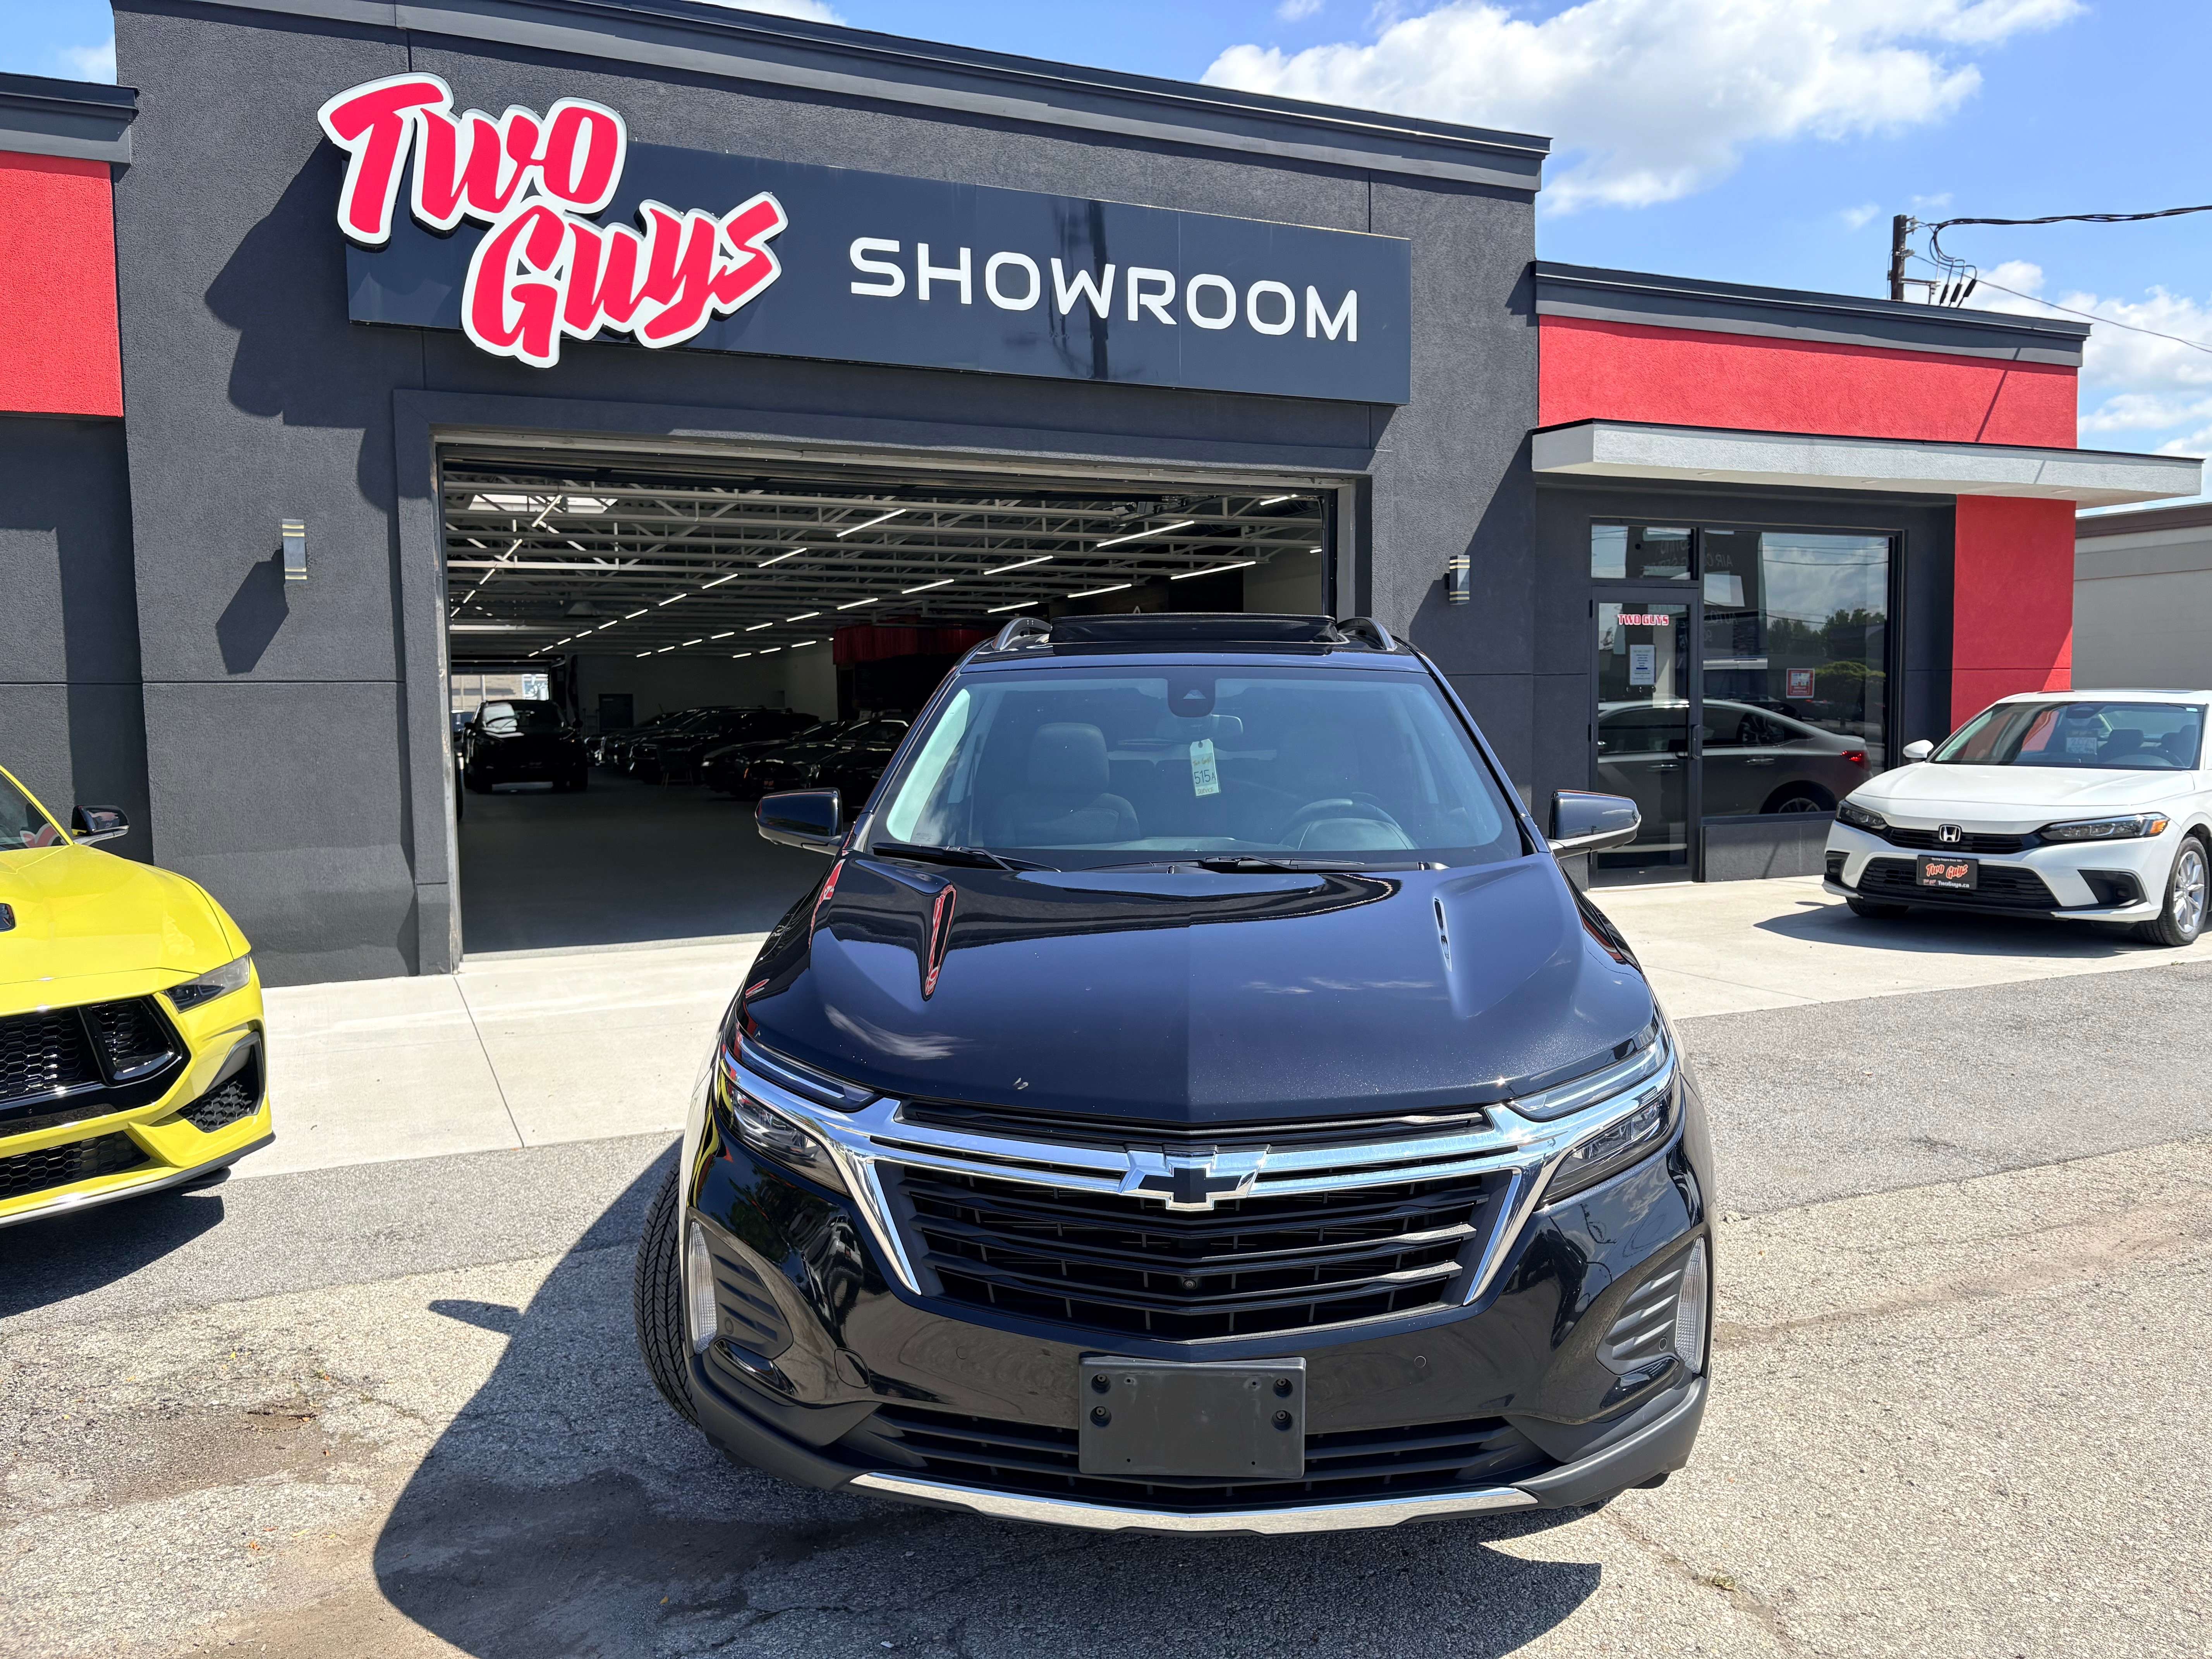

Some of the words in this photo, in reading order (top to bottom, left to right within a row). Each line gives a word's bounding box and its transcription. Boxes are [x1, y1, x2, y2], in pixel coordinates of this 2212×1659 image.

[318, 71, 627, 245] Two
[461, 191, 788, 369] Guys
[850, 237, 1357, 342] SHOWROOM
[1617, 614, 1641, 625] TWO
[1642, 614, 1669, 626] GUYS
[1926, 863, 1944, 877] Two
[1946, 864, 1968, 879] Guys
[1938, 880, 1970, 888] TwoGuys.ca
